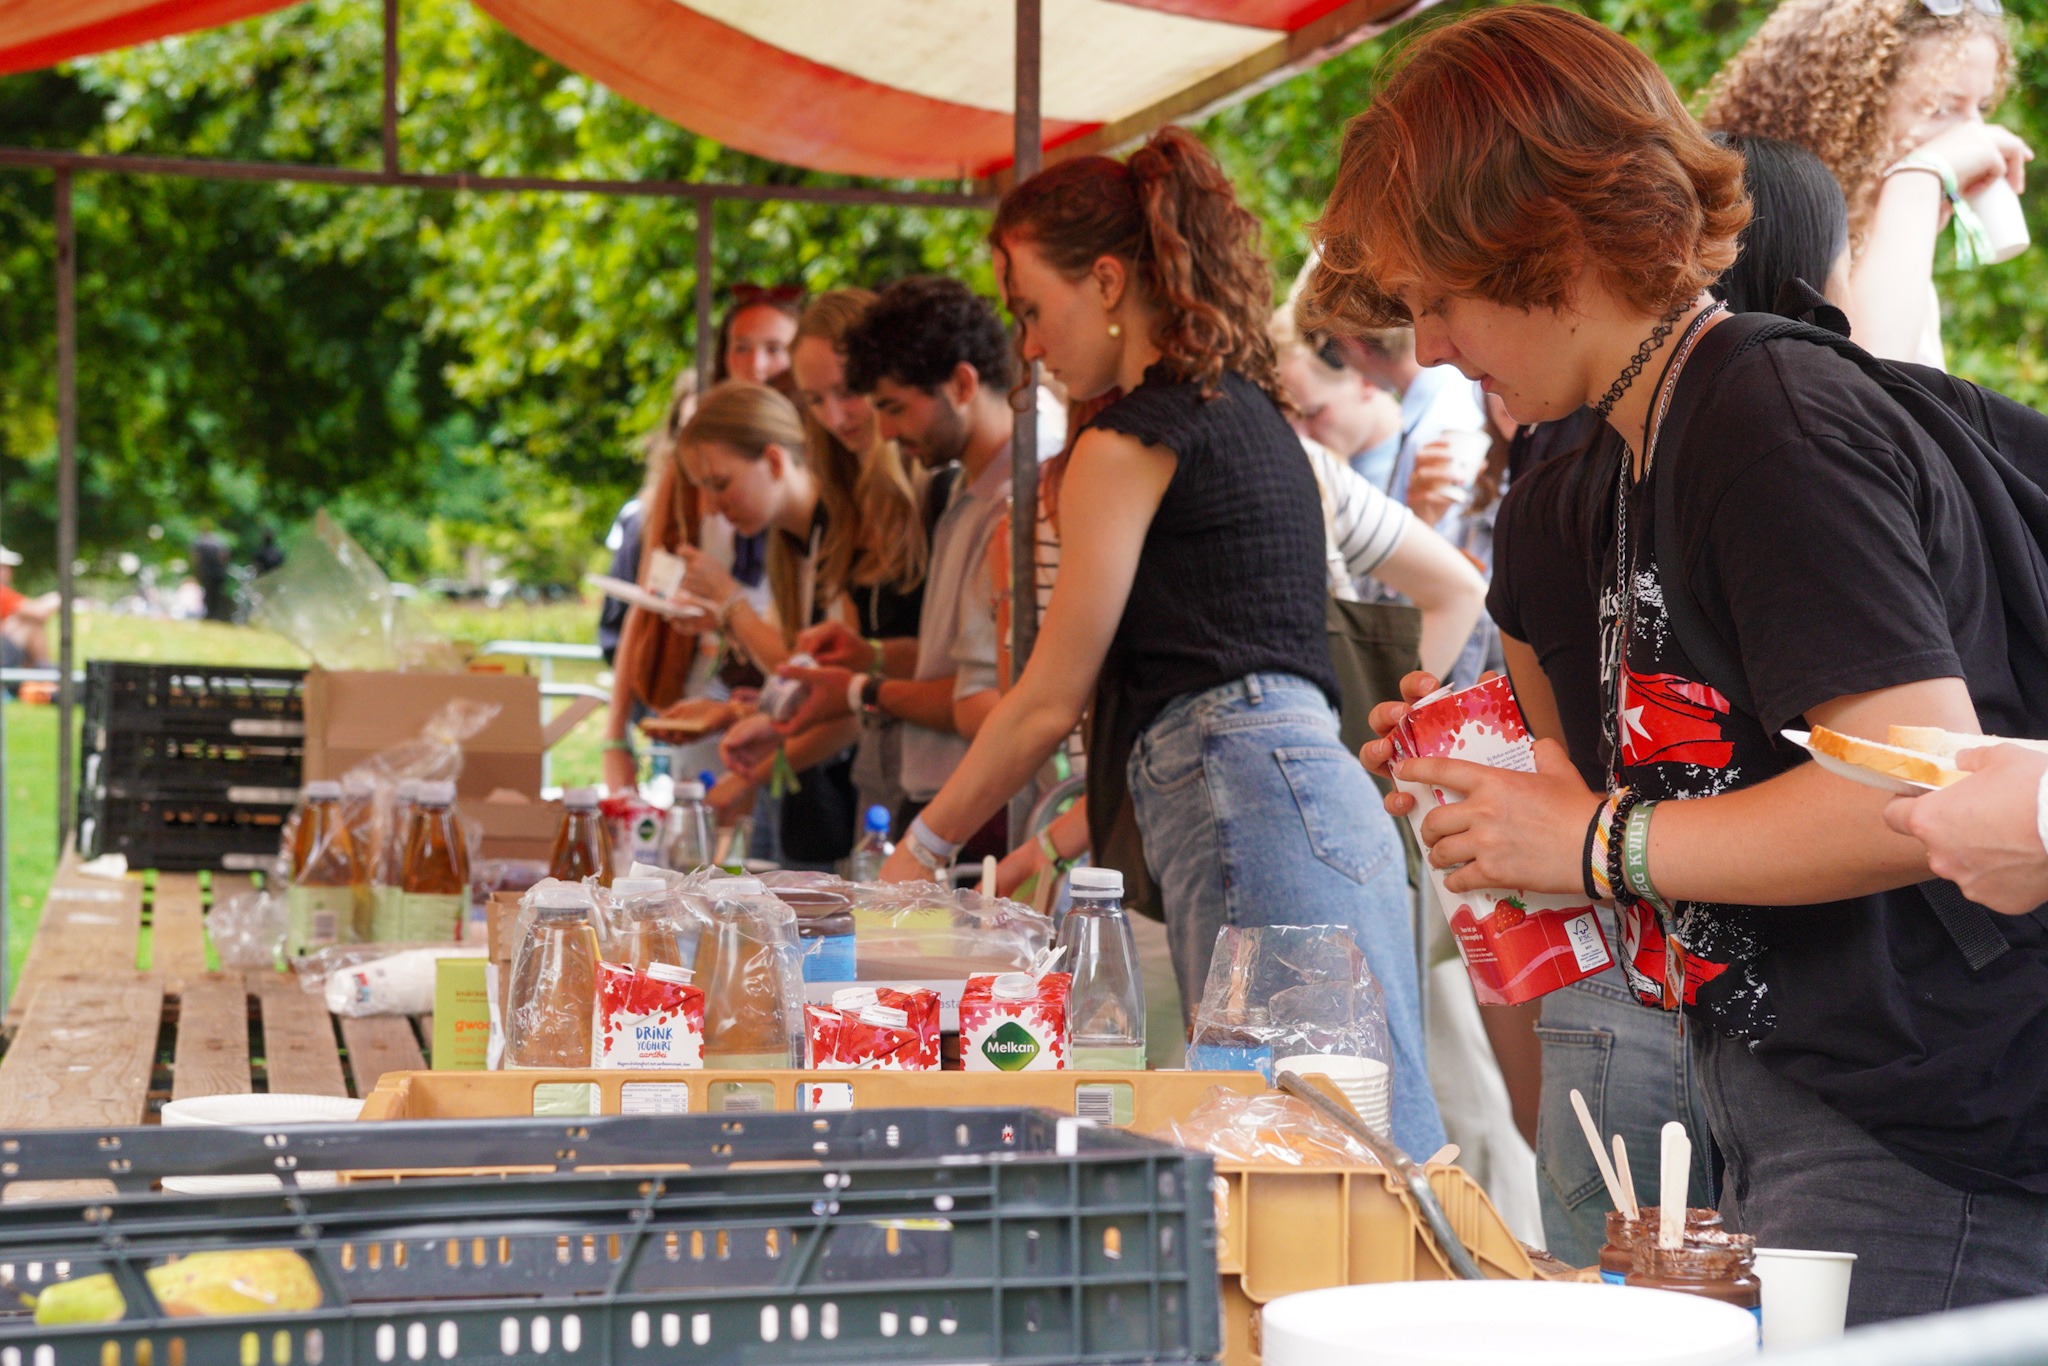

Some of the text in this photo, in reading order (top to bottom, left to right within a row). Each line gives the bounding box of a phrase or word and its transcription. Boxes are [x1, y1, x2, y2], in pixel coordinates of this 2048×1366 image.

[1628, 812, 1647, 866] KWIJT
[637, 1041, 672, 1051] YOGHURT
[987, 1041, 1035, 1053] Melkan
